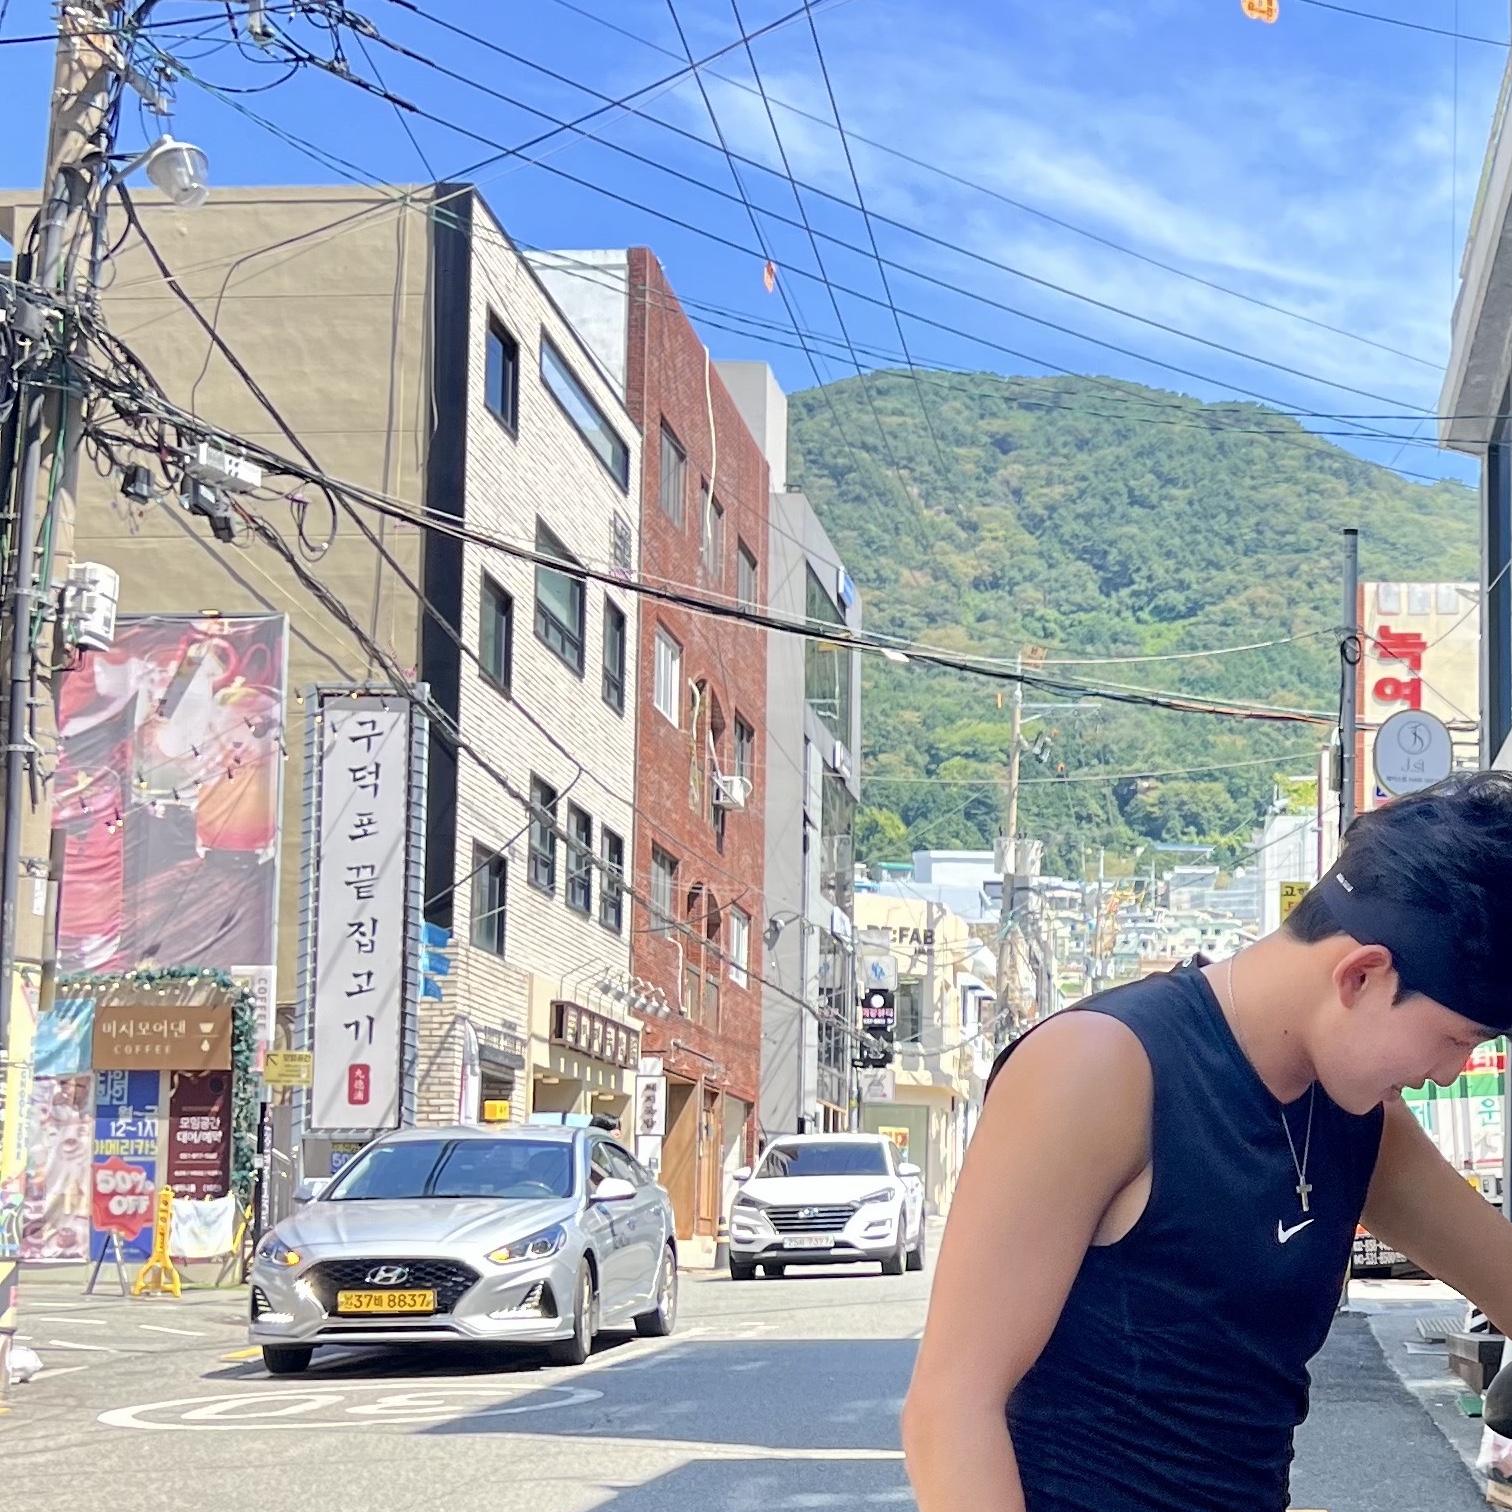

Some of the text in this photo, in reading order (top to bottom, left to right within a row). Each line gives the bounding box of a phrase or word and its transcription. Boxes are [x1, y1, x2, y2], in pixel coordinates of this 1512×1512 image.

[114, 1044, 172, 1055] COFFEE
[97, 1169, 154, 1194] 50%
[109, 1195, 149, 1215] OFF
[387, 1294, 427, 1308] 8837
